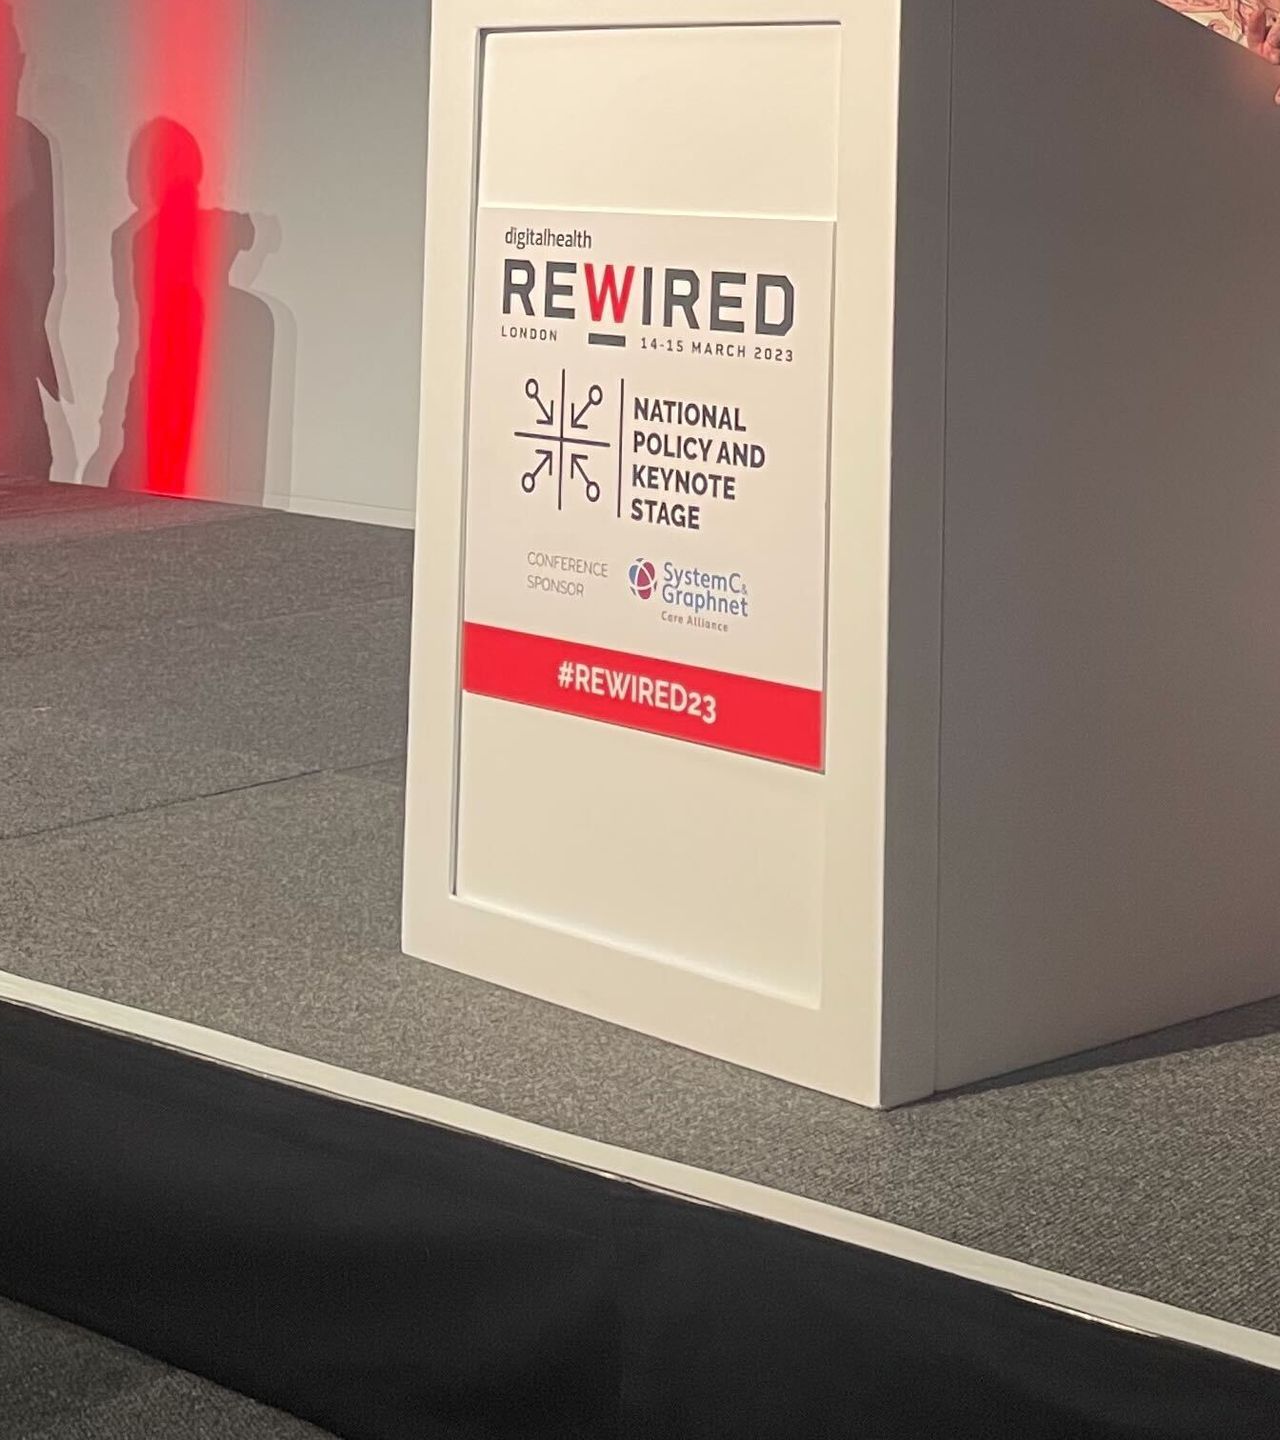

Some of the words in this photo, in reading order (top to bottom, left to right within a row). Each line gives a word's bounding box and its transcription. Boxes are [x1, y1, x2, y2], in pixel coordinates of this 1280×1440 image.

[505, 226, 592, 250] digitalhealth
[502, 258, 794, 336] REWIRED
[501, 325, 558, 341] LONDON
[641, 337, 684, 352] 14-15
[691, 342, 746, 358] MARCH
[754, 347, 794, 362] 2023
[634, 397, 747, 432] NATIONAL
[633, 430, 713, 462] POLICY
[716, 441, 766, 469] AND
[632, 464, 735, 500] KEYNOTE
[631, 498, 700, 529] STAGE
[527, 551, 608, 578] CONFERENCE
[527, 575, 585, 597] SPONSOR
[662, 584, 749, 617] Graphnet
[687, 615, 729, 632] Alliance
[557, 660, 717, 724] #REWIRED23
